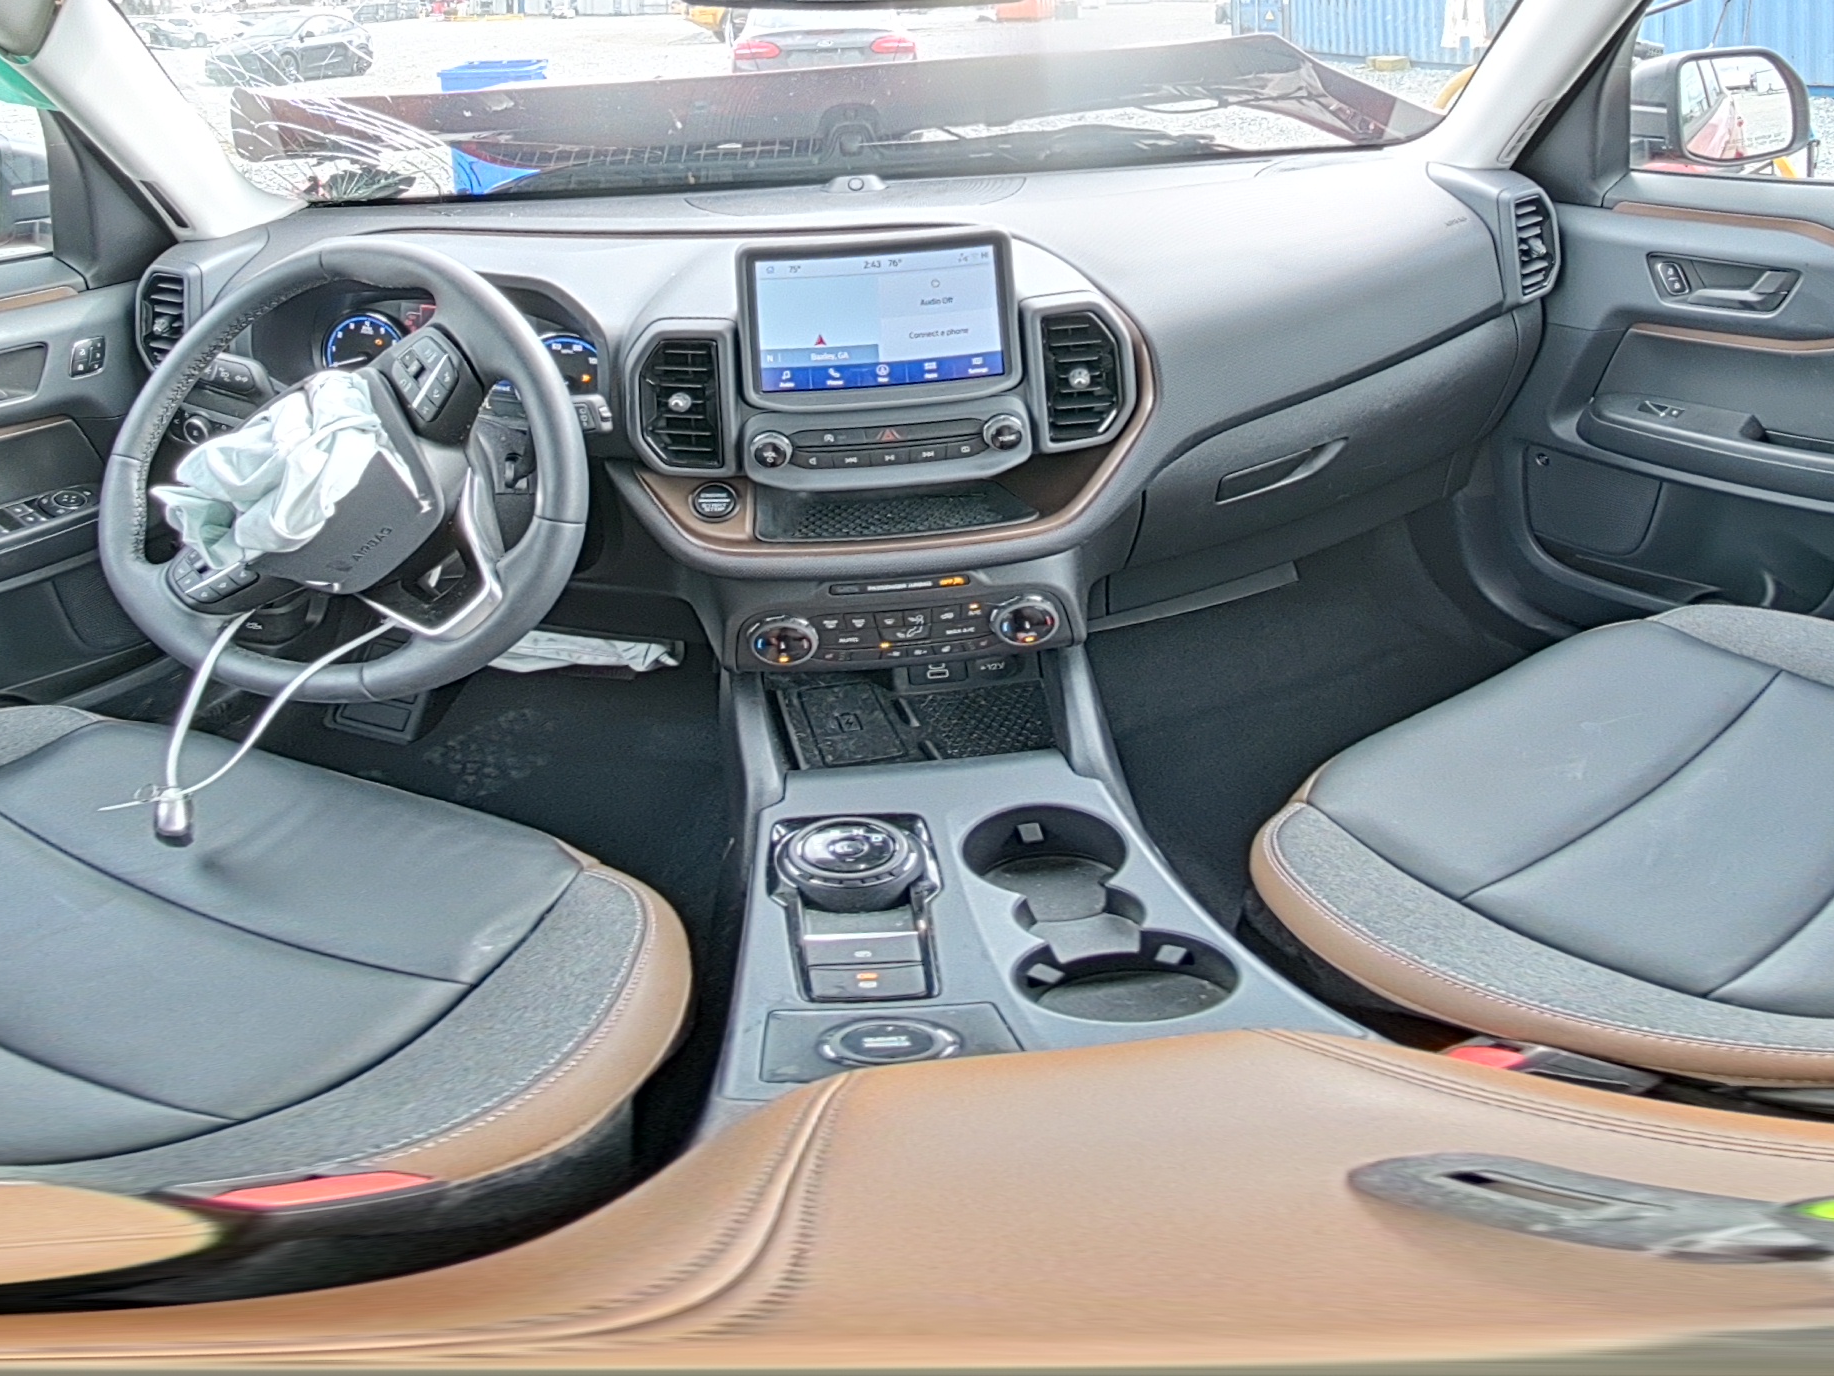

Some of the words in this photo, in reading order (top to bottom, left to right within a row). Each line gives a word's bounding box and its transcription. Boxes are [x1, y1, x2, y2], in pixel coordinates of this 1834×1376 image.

[864, 260, 881, 269] 2:43
[888, 258, 902, 267] 76°
[920, 298, 940, 306] Audio
[941, 296, 954, 305] Off
[909, 331, 939, 339] Connect
[946, 327, 969, 338] phone
[767, 354, 774, 362] N
[837, 351, 849, 360] GA
[352, 527, 393, 562] AIRBAG
